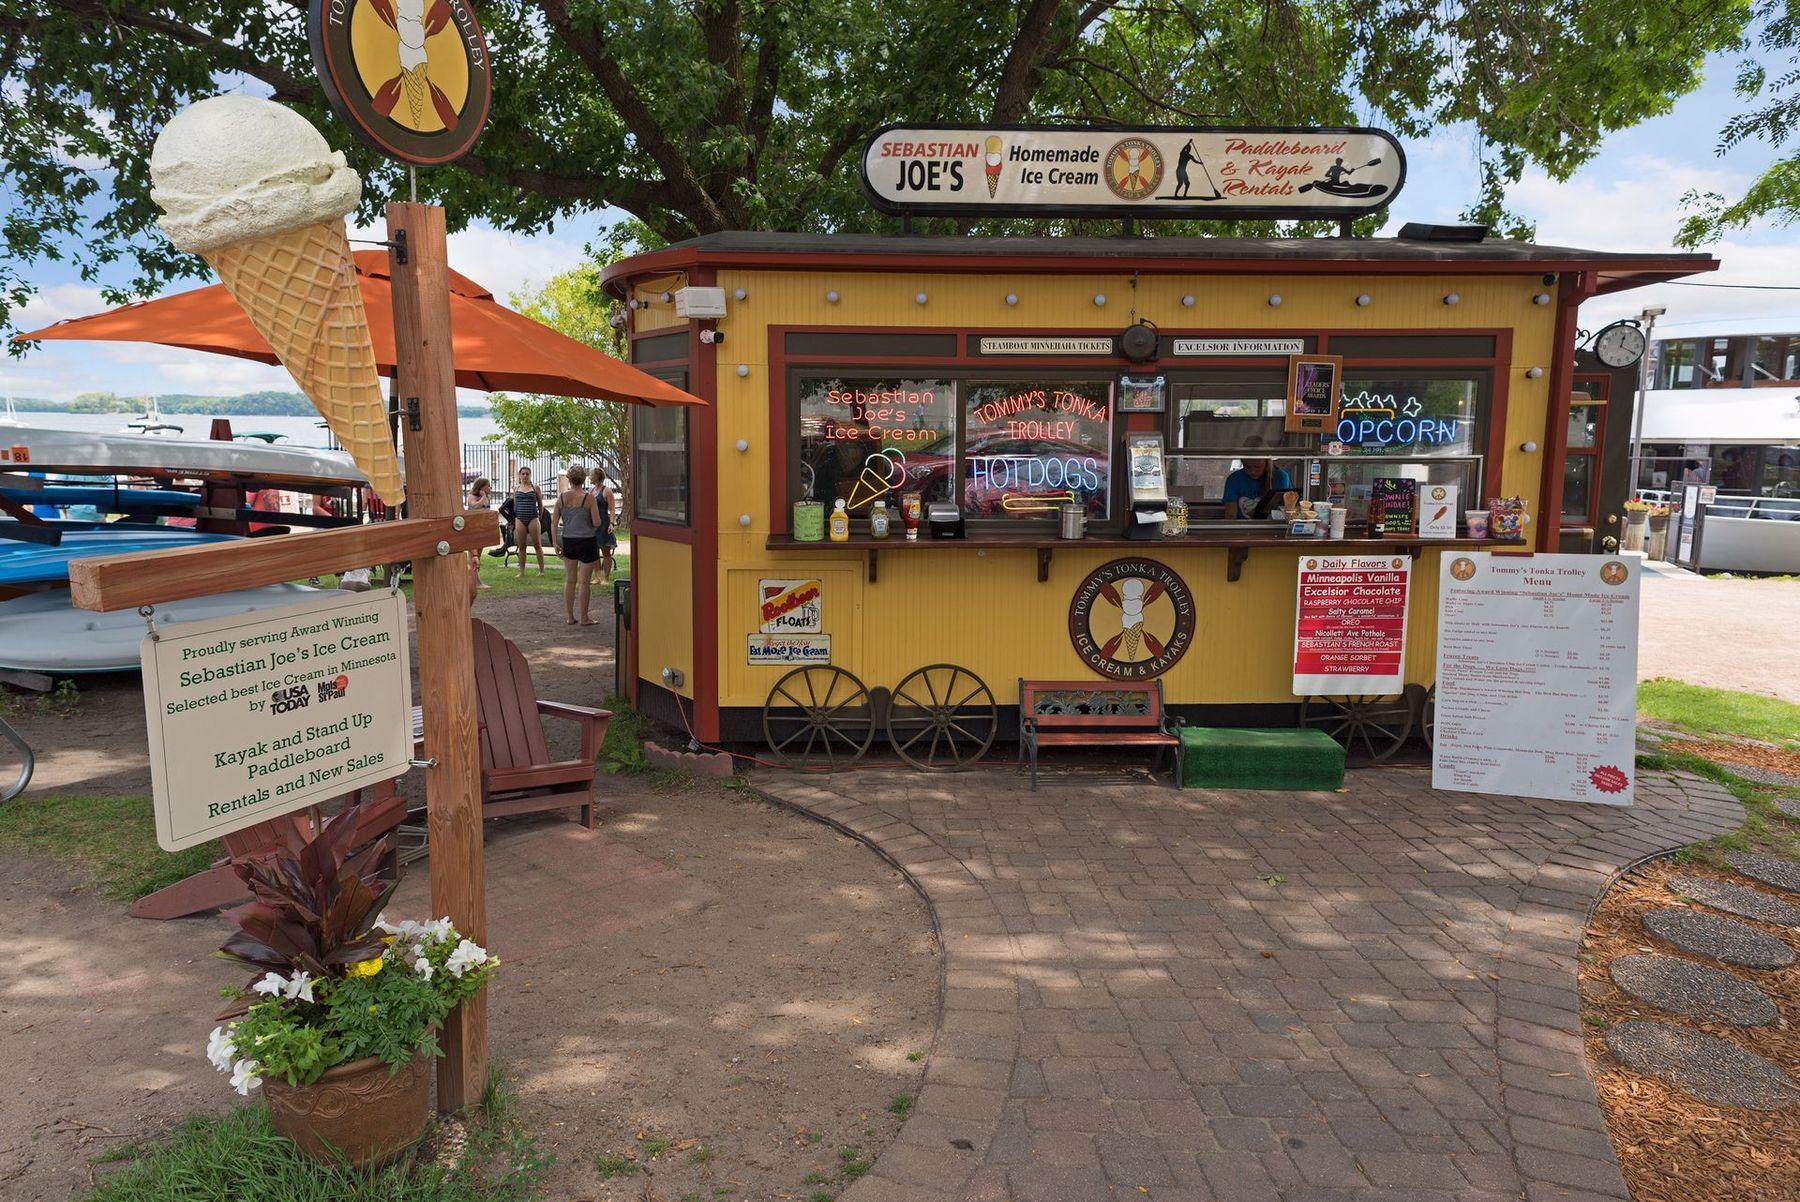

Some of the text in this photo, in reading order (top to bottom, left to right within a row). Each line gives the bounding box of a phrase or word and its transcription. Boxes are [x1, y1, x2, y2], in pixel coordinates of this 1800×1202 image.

[449, 0, 485, 70] ROLLEY
[881, 142, 979, 158] SEBASTIAN
[1009, 145, 1099, 163] Homemade
[1225, 138, 1347, 155] Paddleboard
[896, 160, 964, 192] JOE'S
[1021, 168, 1098, 185] Ice Cream
[1220, 159, 1313, 180] & Kayak
[1222, 179, 1293, 196] Rentals
[982, 340, 1110, 351] STEAMBOAT MINNEHAHA TICKETS
[1178, 341, 1300, 352] EXCELSIOR INFORMATION
[827, 389, 935, 405] Sebastian
[852, 407, 906, 422] Joe's
[973, 390, 1046, 425] TOMMY'S
[1054, 391, 1106, 424] TONKA
[826, 425, 937, 441] Ice Cream
[1008, 421, 1075, 440] TROLLEY
[1336, 419, 1457, 443] OPCORN
[973, 457, 1020, 490] HOT
[1028, 457, 1098, 490] DOGS
[1322, 559, 1387, 570] Daily Flavors
[1490, 566, 1586, 577] Tommy's Tonka Trolley
[1306, 573, 1400, 584] Minneapolis Vanilla
[1524, 577, 1552, 586] Menu
[1075, 563, 1190, 616] TOMMY'S TONKA TROLLEY
[1304, 586, 1401, 596] Excelsior Chocolate
[776, 616, 810, 628] FLOATS
[181, 611, 379, 661] Proudly serving Award Winning
[180, 631, 390, 688] Sebastian Joe's Ice Cream
[750, 646, 828, 657] Eat More Ice Cream
[1076, 632, 1187, 676] ICE CREAM & KAYAKS
[166, 652, 396, 715] Selected best Ice Cream in Minnesota
[249, 685, 309, 713] by USA
[270, 695, 310, 716] TODAY
[214, 712, 373, 769] Kayak and Stand Up
[247, 737, 351, 779] Paddleboard
[208, 752, 384, 818] Rentals and New Sales
